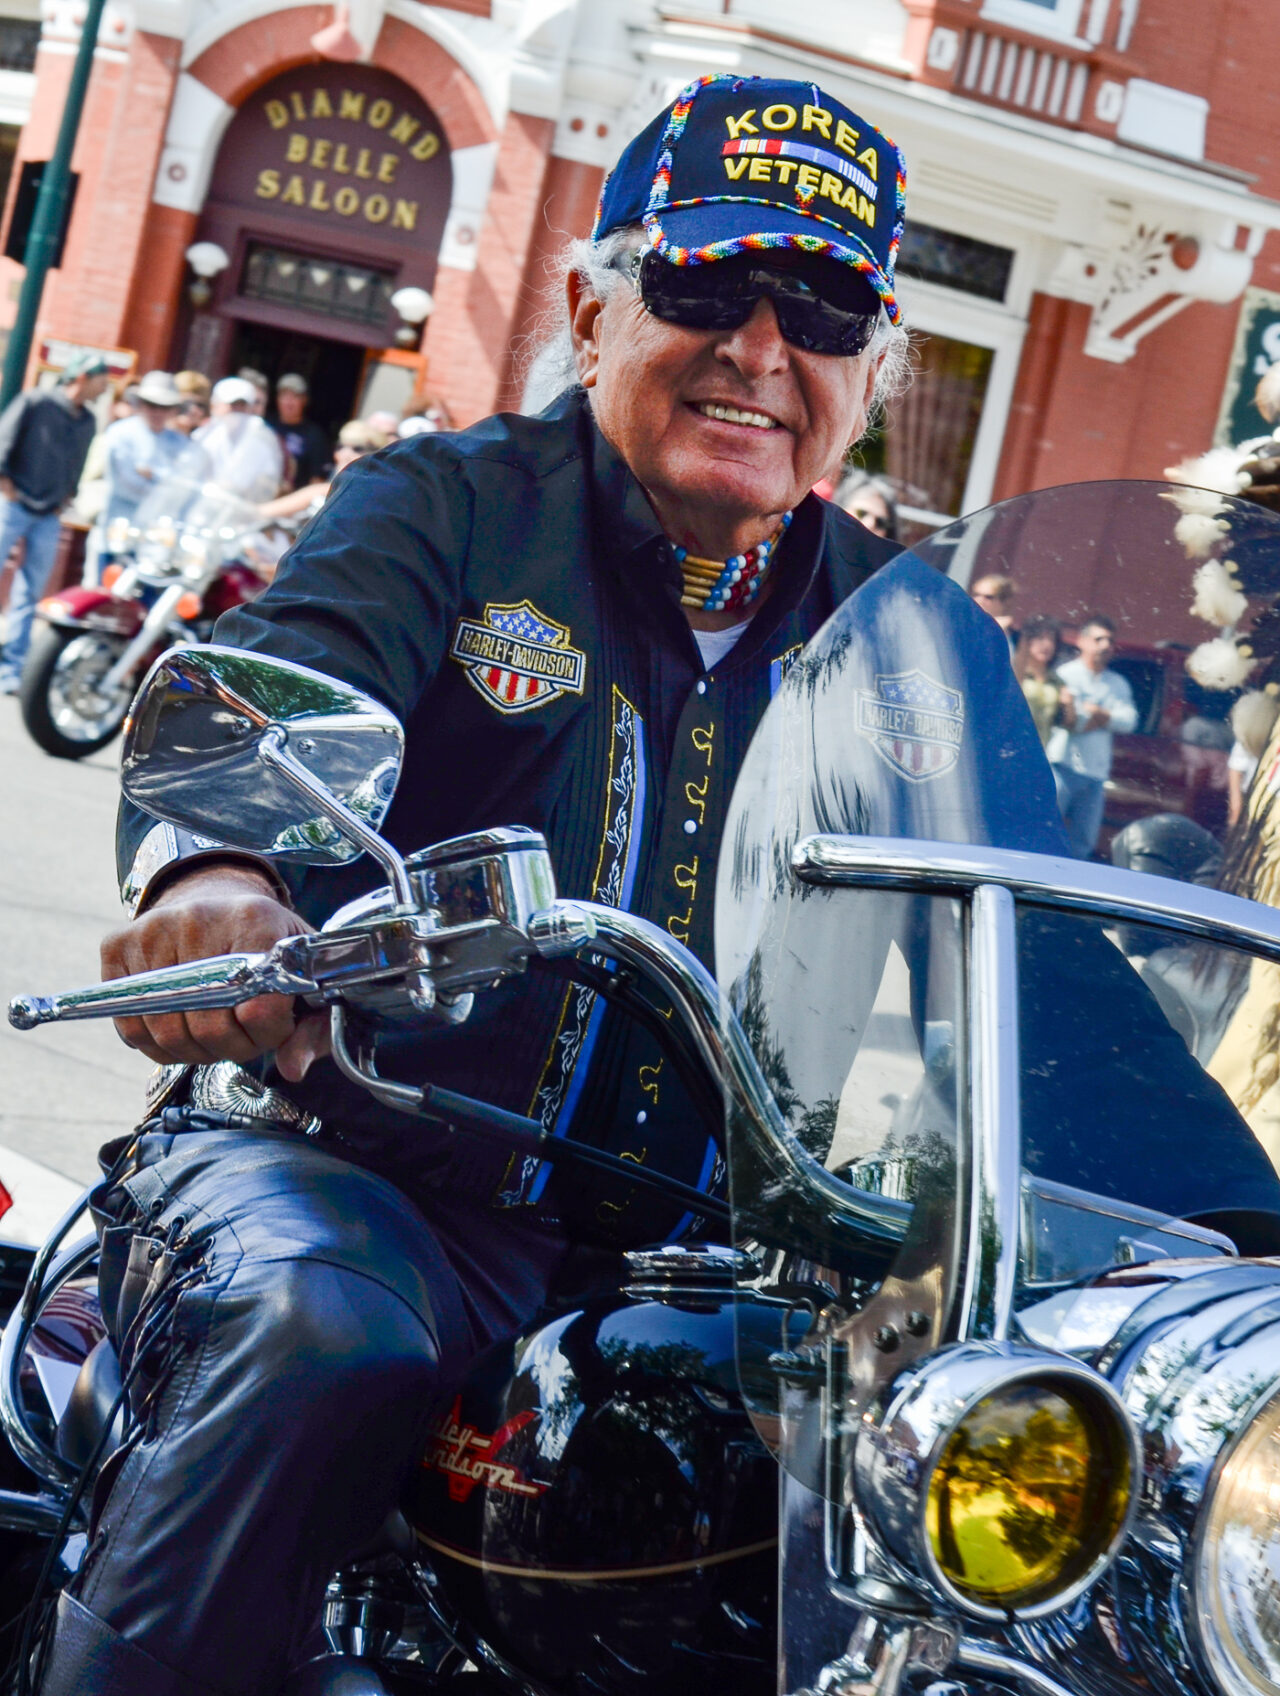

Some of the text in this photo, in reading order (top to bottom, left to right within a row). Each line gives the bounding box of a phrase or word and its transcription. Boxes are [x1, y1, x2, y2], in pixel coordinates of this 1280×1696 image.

[265, 89, 440, 161] DIAMOND
[725, 104, 878, 181] KOREA
[286, 134, 399, 183] BELLE
[255, 169, 418, 231] SALOON
[724, 157, 876, 228] VETERAN
[459, 629, 576, 679] HARLEY-DAVIDSON
[862, 704, 962, 741] HARLEY-DAVIDSO
